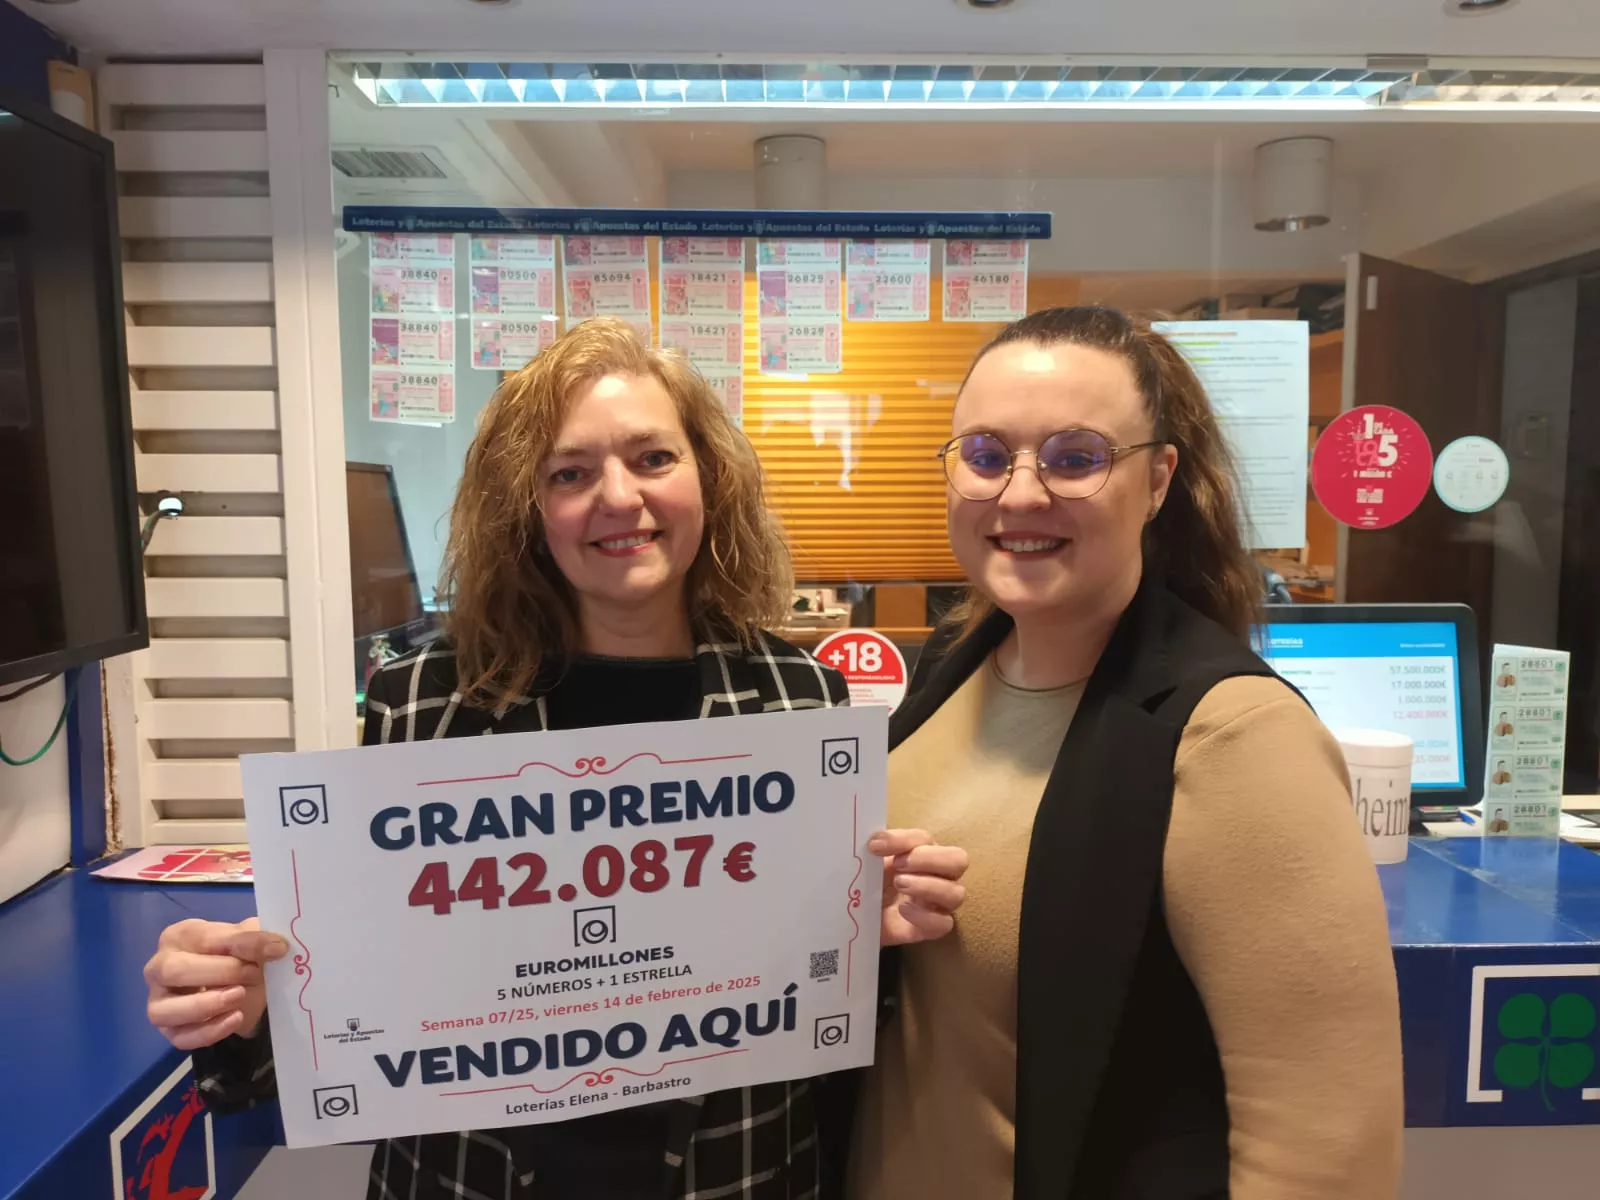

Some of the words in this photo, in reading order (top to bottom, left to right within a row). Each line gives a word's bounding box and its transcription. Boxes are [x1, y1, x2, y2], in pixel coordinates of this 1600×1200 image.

[1363, 413, 1375, 439] 1
[1378, 434, 1398, 467] 5
[828, 641, 883, 673] +18
[370, 792, 555, 851] GRAN
[570, 771, 795, 832] PREMIO
[408, 834, 714, 915] 442.087
[723, 841, 757, 882] €
[515, 946, 675, 978] EUROMILLONES
[497, 988, 507, 1001] 5
[511, 977, 593, 999] NÚMEROS
[596, 980, 605, 988] +
[610, 974, 619, 986] 1
[623, 964, 692, 984] ESTRELLA
[421, 1016, 484, 1032] Semana
[488, 1007, 539, 1024] 07/25,
[544, 1001, 599, 1017] viernes
[604, 996, 620, 1009] 14
[625, 994, 643, 1006] de
[648, 985, 702, 1002] febrero
[705, 981, 723, 993] de
[727, 975, 761, 991] 2025
[374, 1022, 648, 1088] VENDIDO
[658, 982, 799, 1052] AQUÍ
[506, 1099, 565, 1115] Loterías
[569, 1092, 609, 1107] Elena
[622, 1076, 692, 1097] Barbastro
